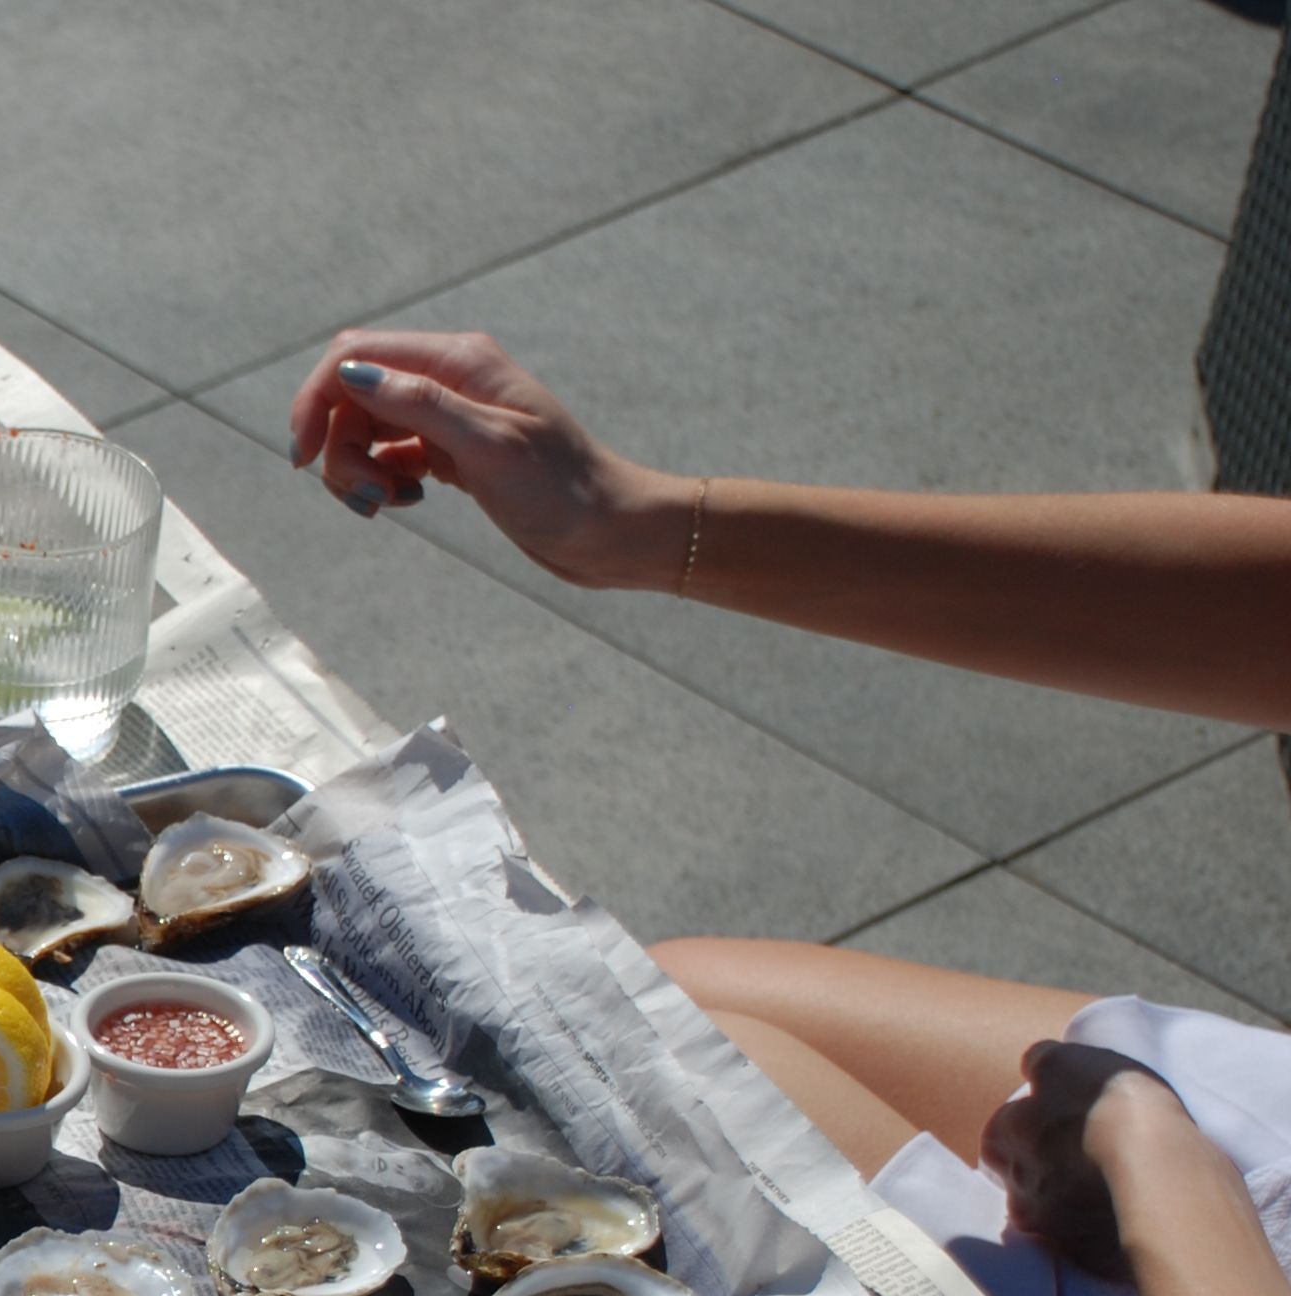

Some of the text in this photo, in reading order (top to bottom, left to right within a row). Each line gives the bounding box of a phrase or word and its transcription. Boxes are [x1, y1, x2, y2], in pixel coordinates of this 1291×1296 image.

[327, 888, 399, 997] Skepticism
[400, 987, 446, 1053] About
[378, 902, 458, 1011] Obliterates
[384, 1026, 420, 1072] Best
[584, 1051, 610, 1083] SPORTS
